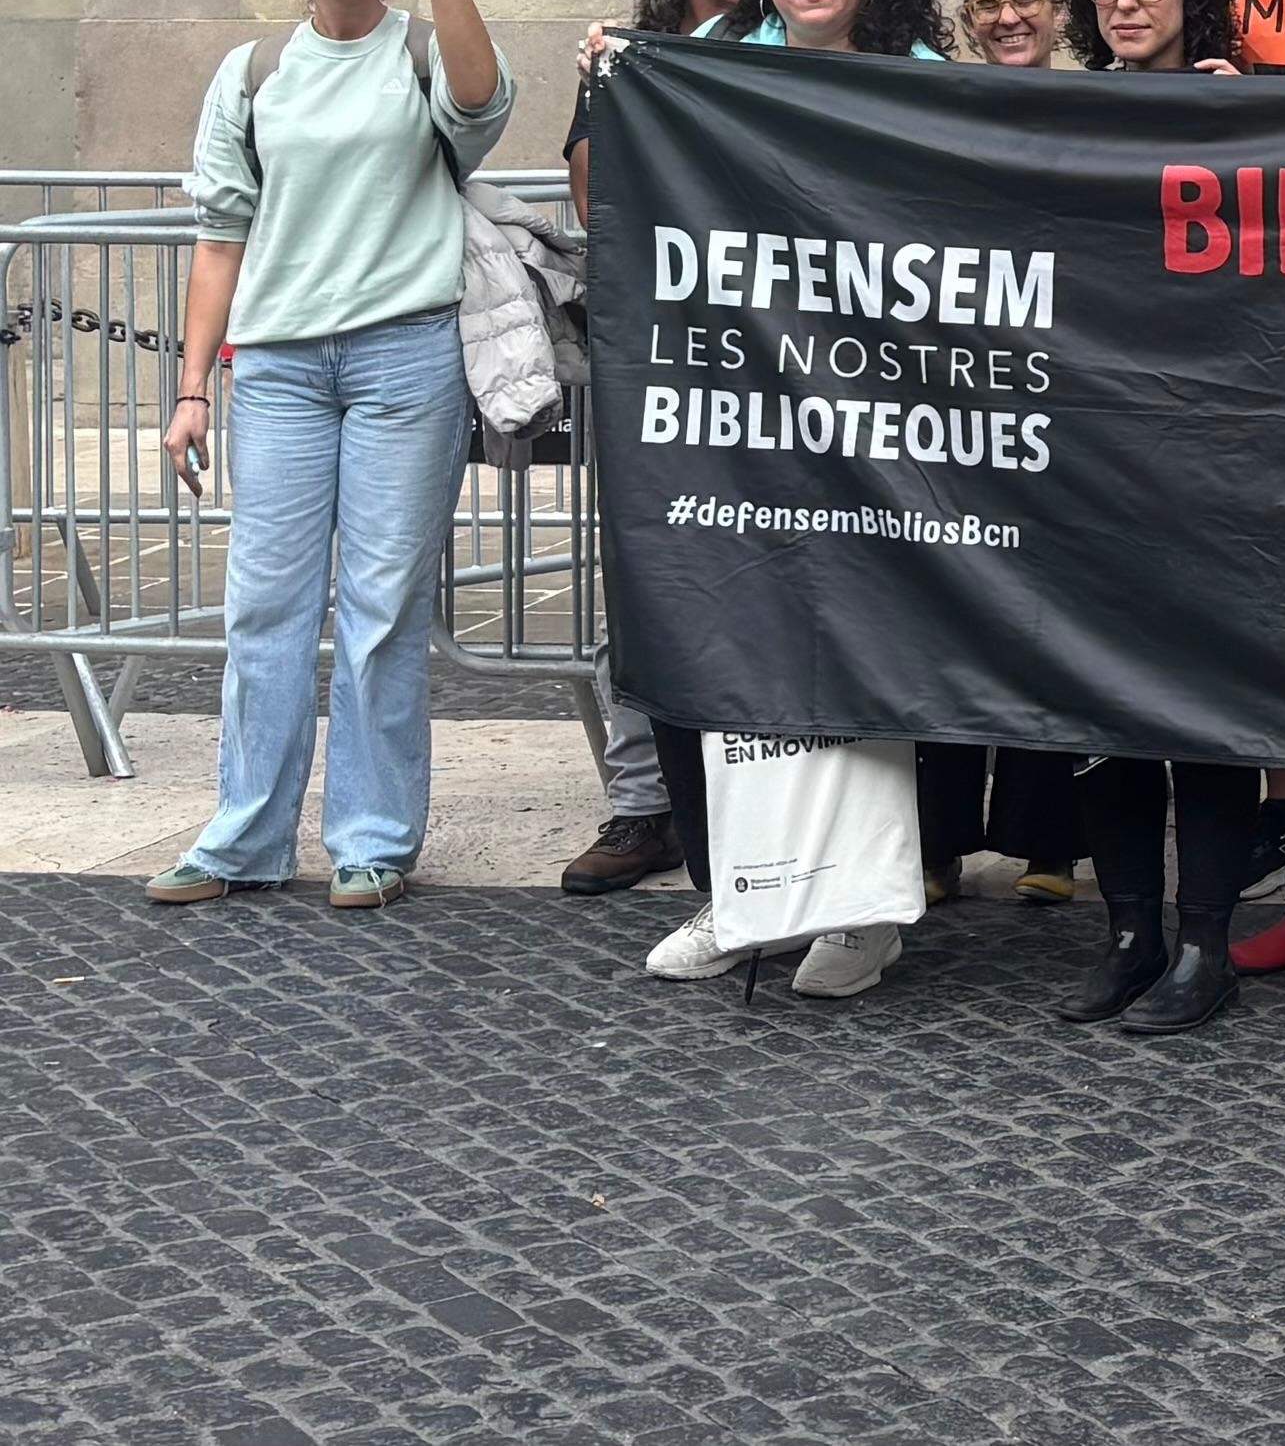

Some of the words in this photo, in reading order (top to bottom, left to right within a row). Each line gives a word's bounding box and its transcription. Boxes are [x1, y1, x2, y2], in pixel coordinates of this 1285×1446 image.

[654, 225, 1055, 329] DEFENSEM
[650, 324, 745, 369] LES
[778, 334, 1050, 393] NOSTRES
[641, 385, 1051, 472] BIBLIOTEQUES
[666, 495, 1020, 548] #defensemBibliosBcn
[725, 745, 755, 764] EN
